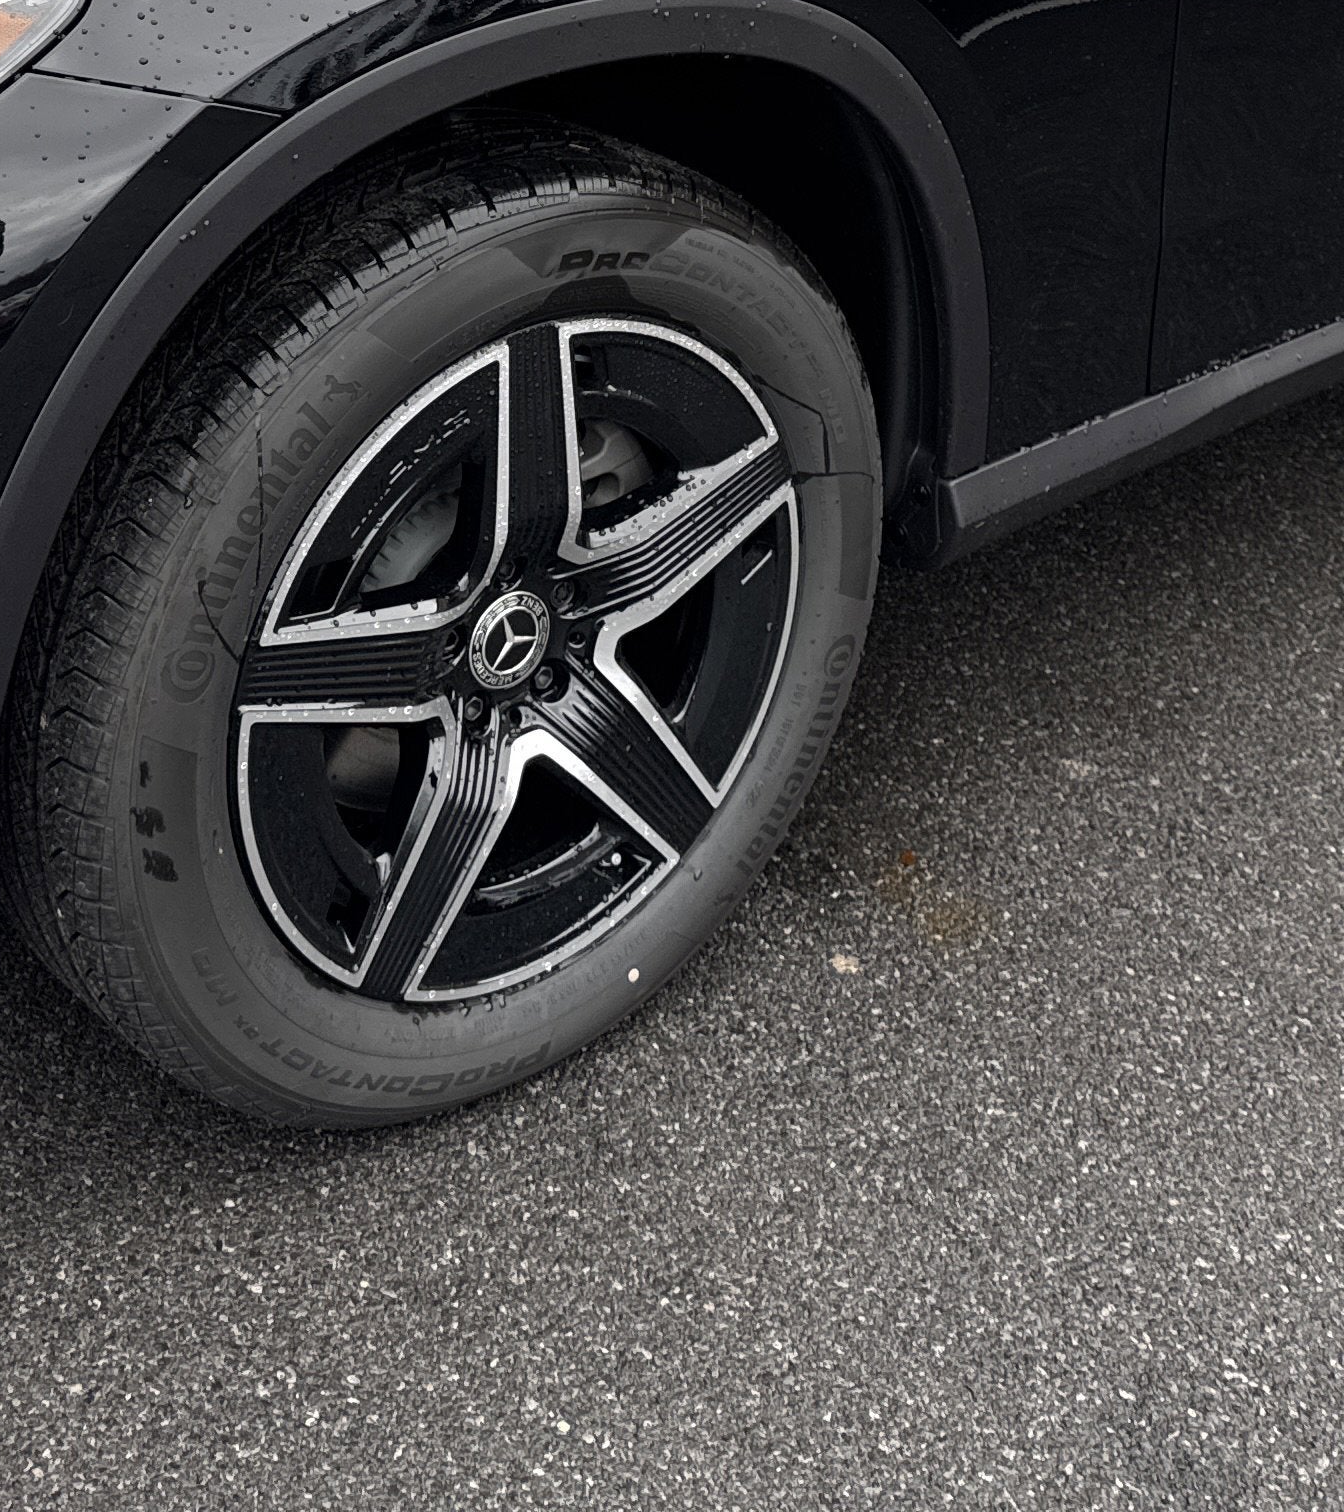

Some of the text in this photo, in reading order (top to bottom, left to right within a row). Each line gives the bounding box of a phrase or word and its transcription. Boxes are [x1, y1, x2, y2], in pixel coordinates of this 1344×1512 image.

[159, 401, 333, 704] Continental
[472, 596, 544, 686] MERCEDES BENZ
[737, 634, 856, 878] Continental
